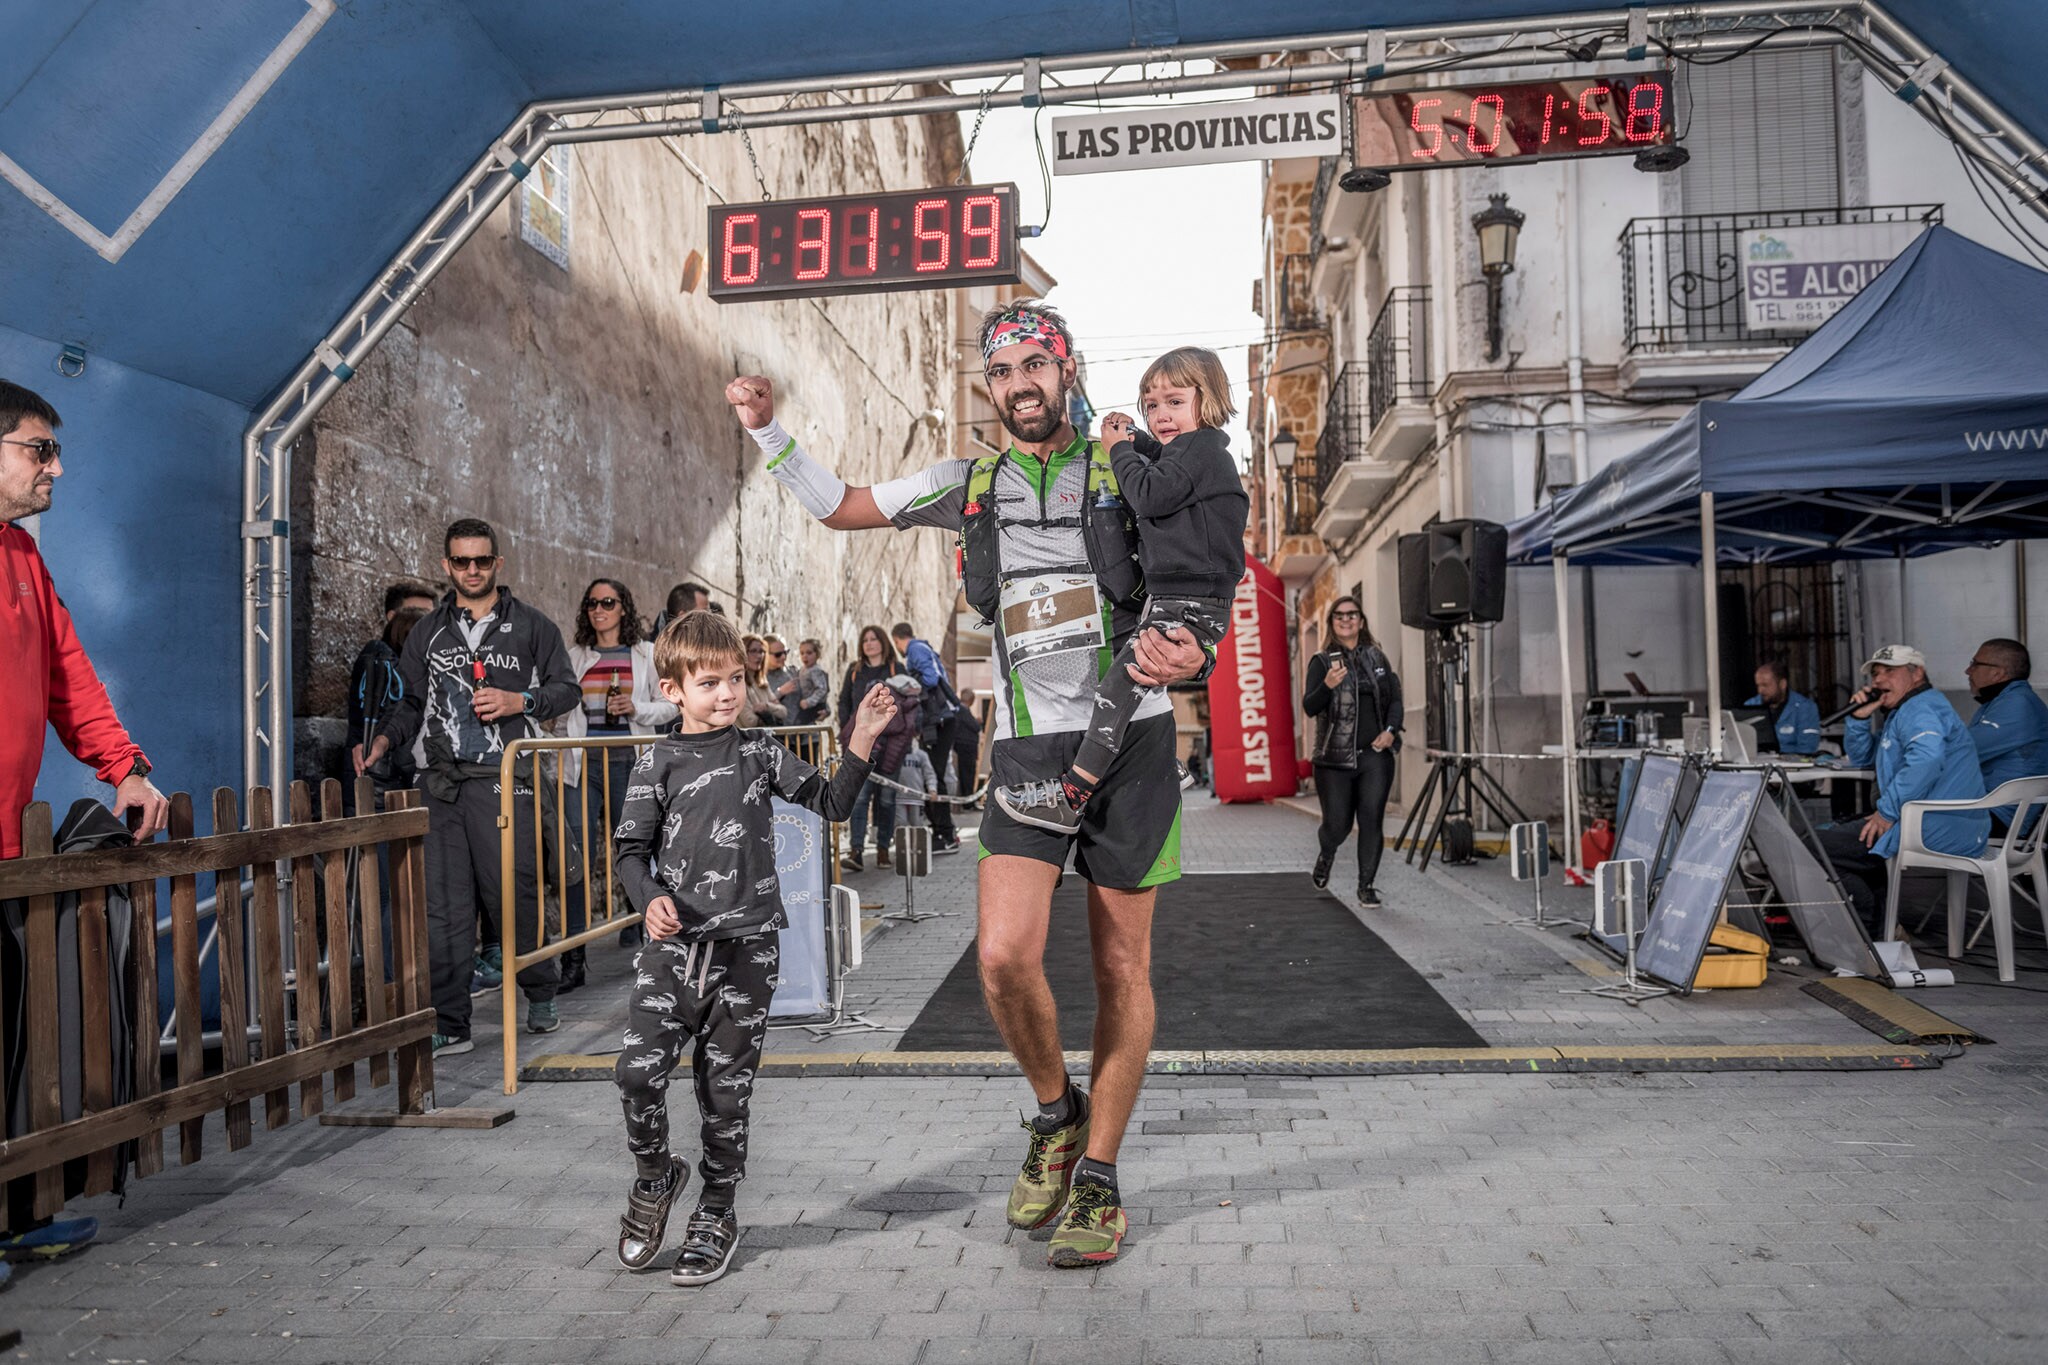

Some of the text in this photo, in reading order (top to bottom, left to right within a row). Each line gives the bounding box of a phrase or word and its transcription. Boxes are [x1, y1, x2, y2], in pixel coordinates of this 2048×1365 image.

[1056, 109, 1337, 160] LAS PROVINCIAS
[1753, 267, 1788, 297] SE
[1027, 596, 1058, 620] 44
[443, 652, 520, 672] SOLANA
[1243, 730, 1272, 784] LAS
